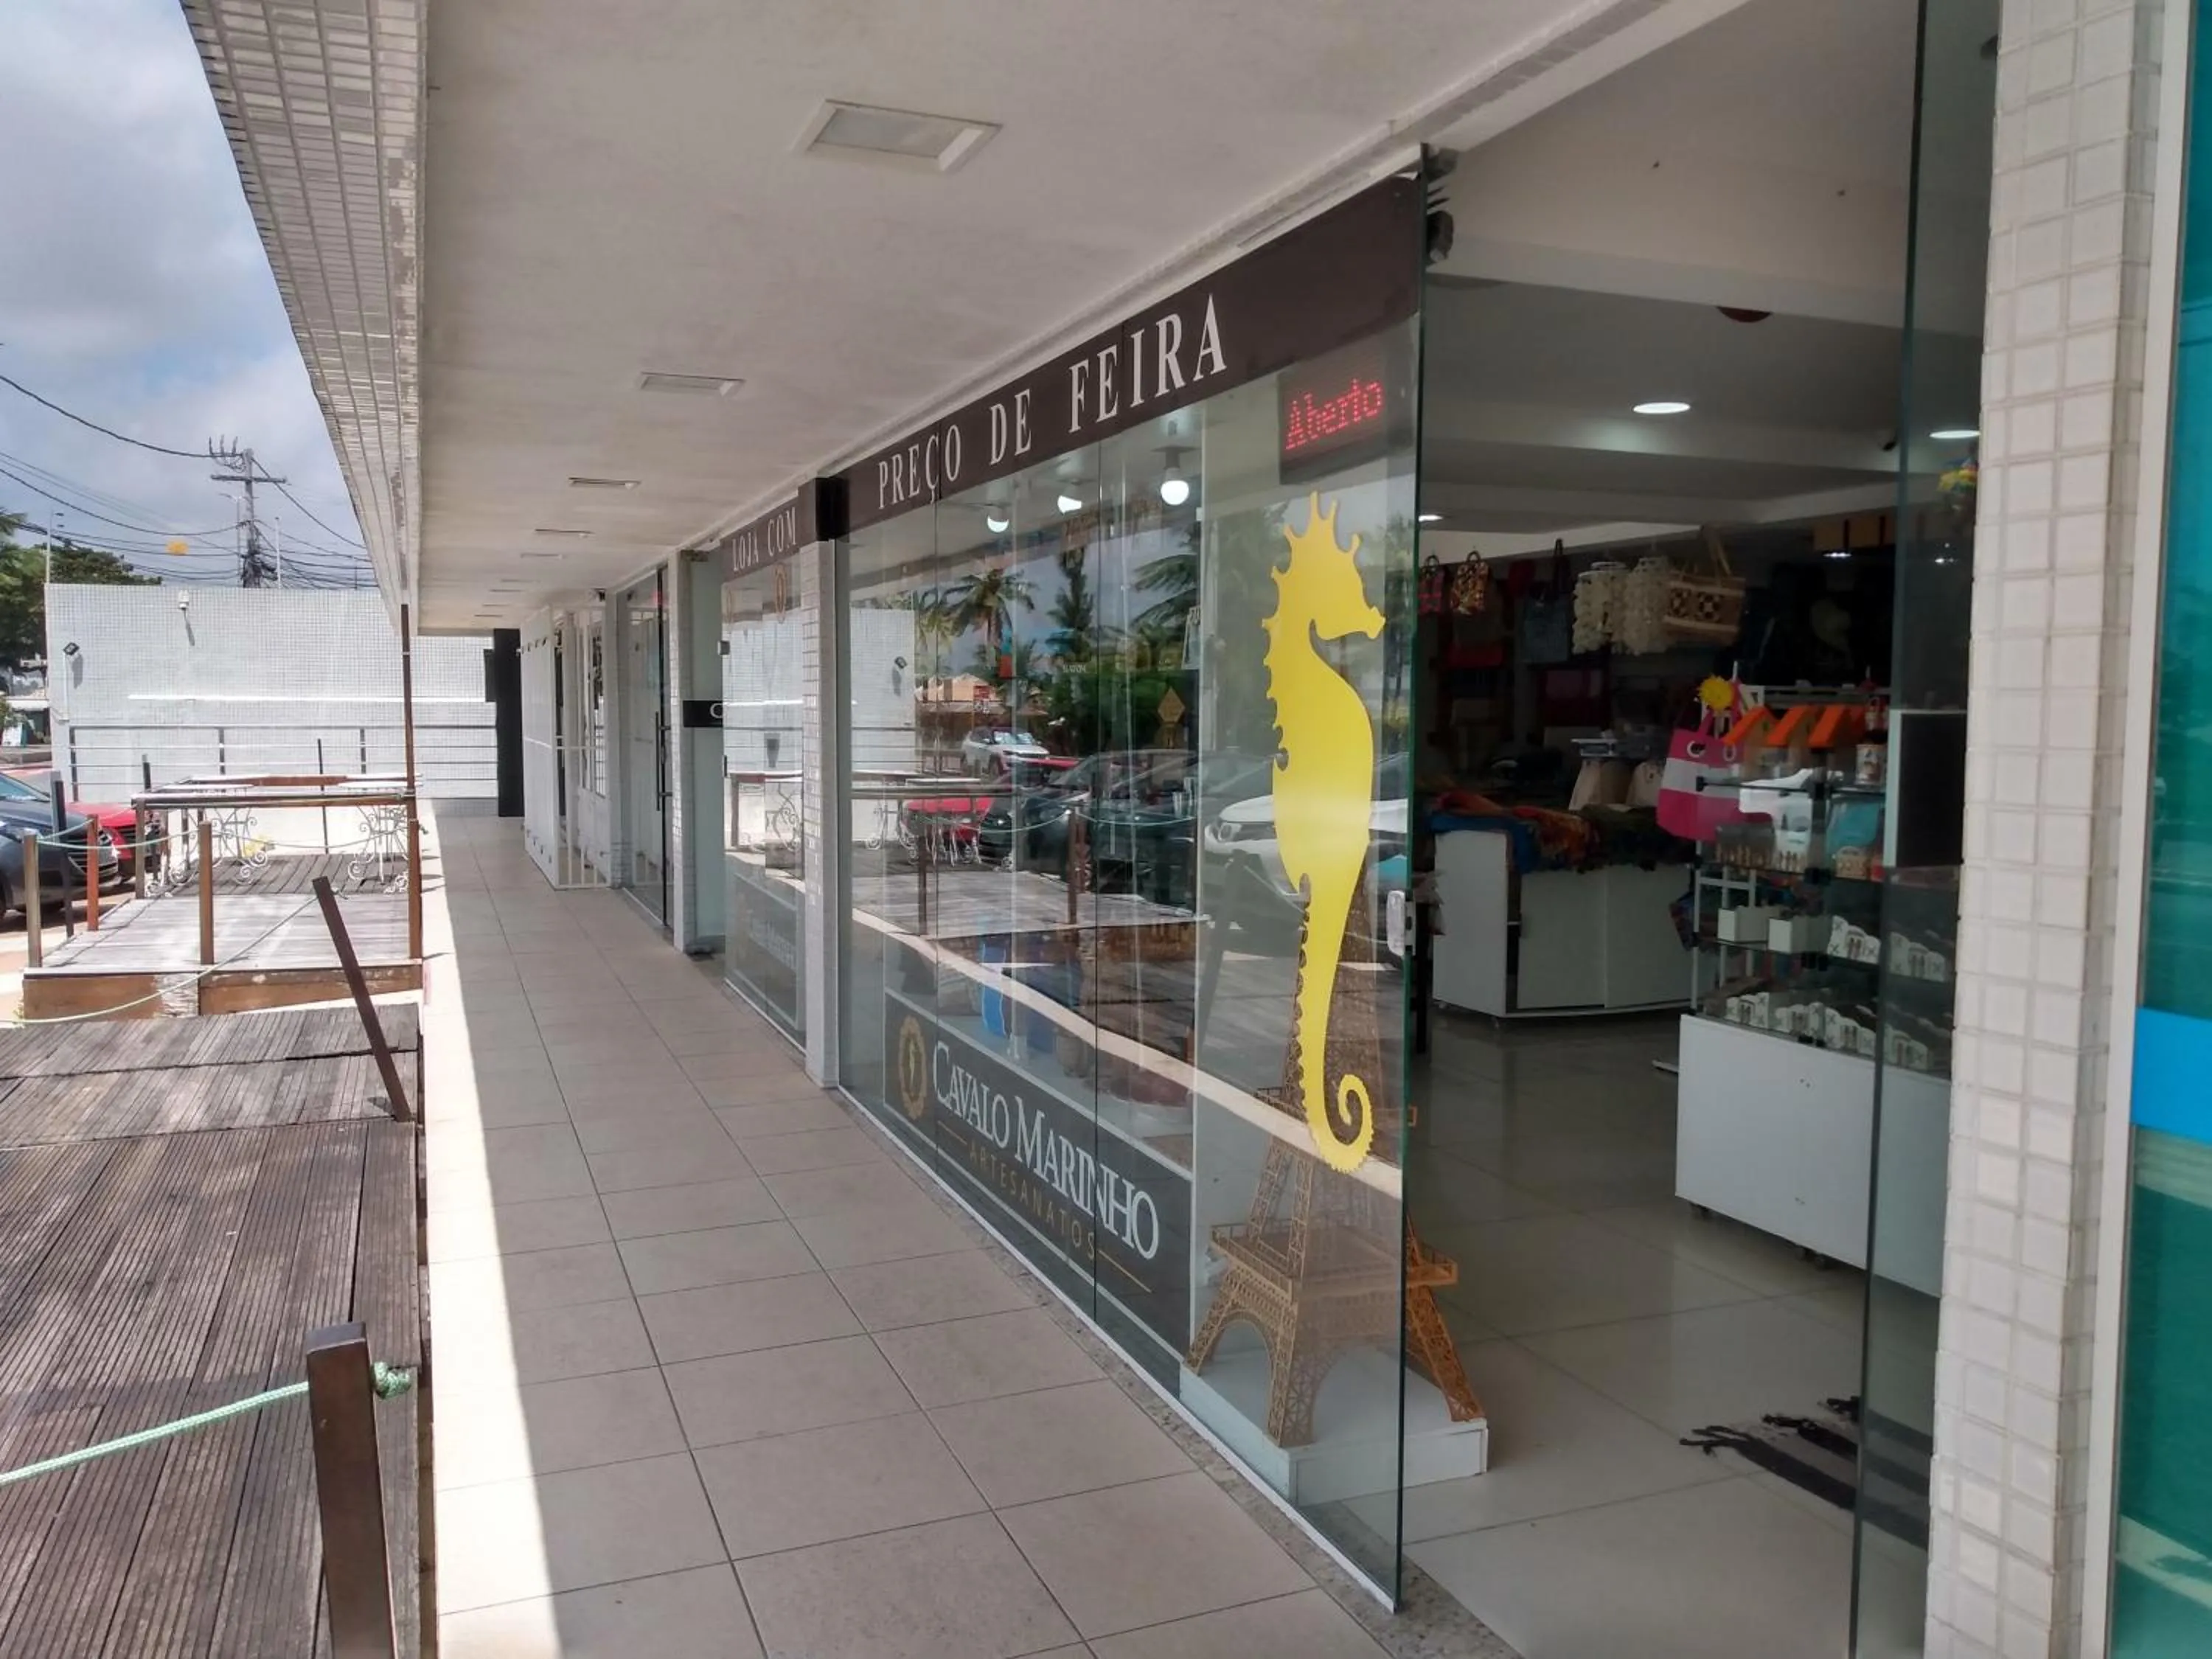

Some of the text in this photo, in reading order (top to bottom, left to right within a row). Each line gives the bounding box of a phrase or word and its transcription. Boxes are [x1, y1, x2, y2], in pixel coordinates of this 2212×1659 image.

[732, 294, 1227, 571] LOJA COM PREÇO DE FEIRA
[1285, 378, 1382, 450] Aberto
[933, 1040, 1159, 1260] CAVALO MARINHO
[970, 1141, 1095, 1260] ARTESANATOS
